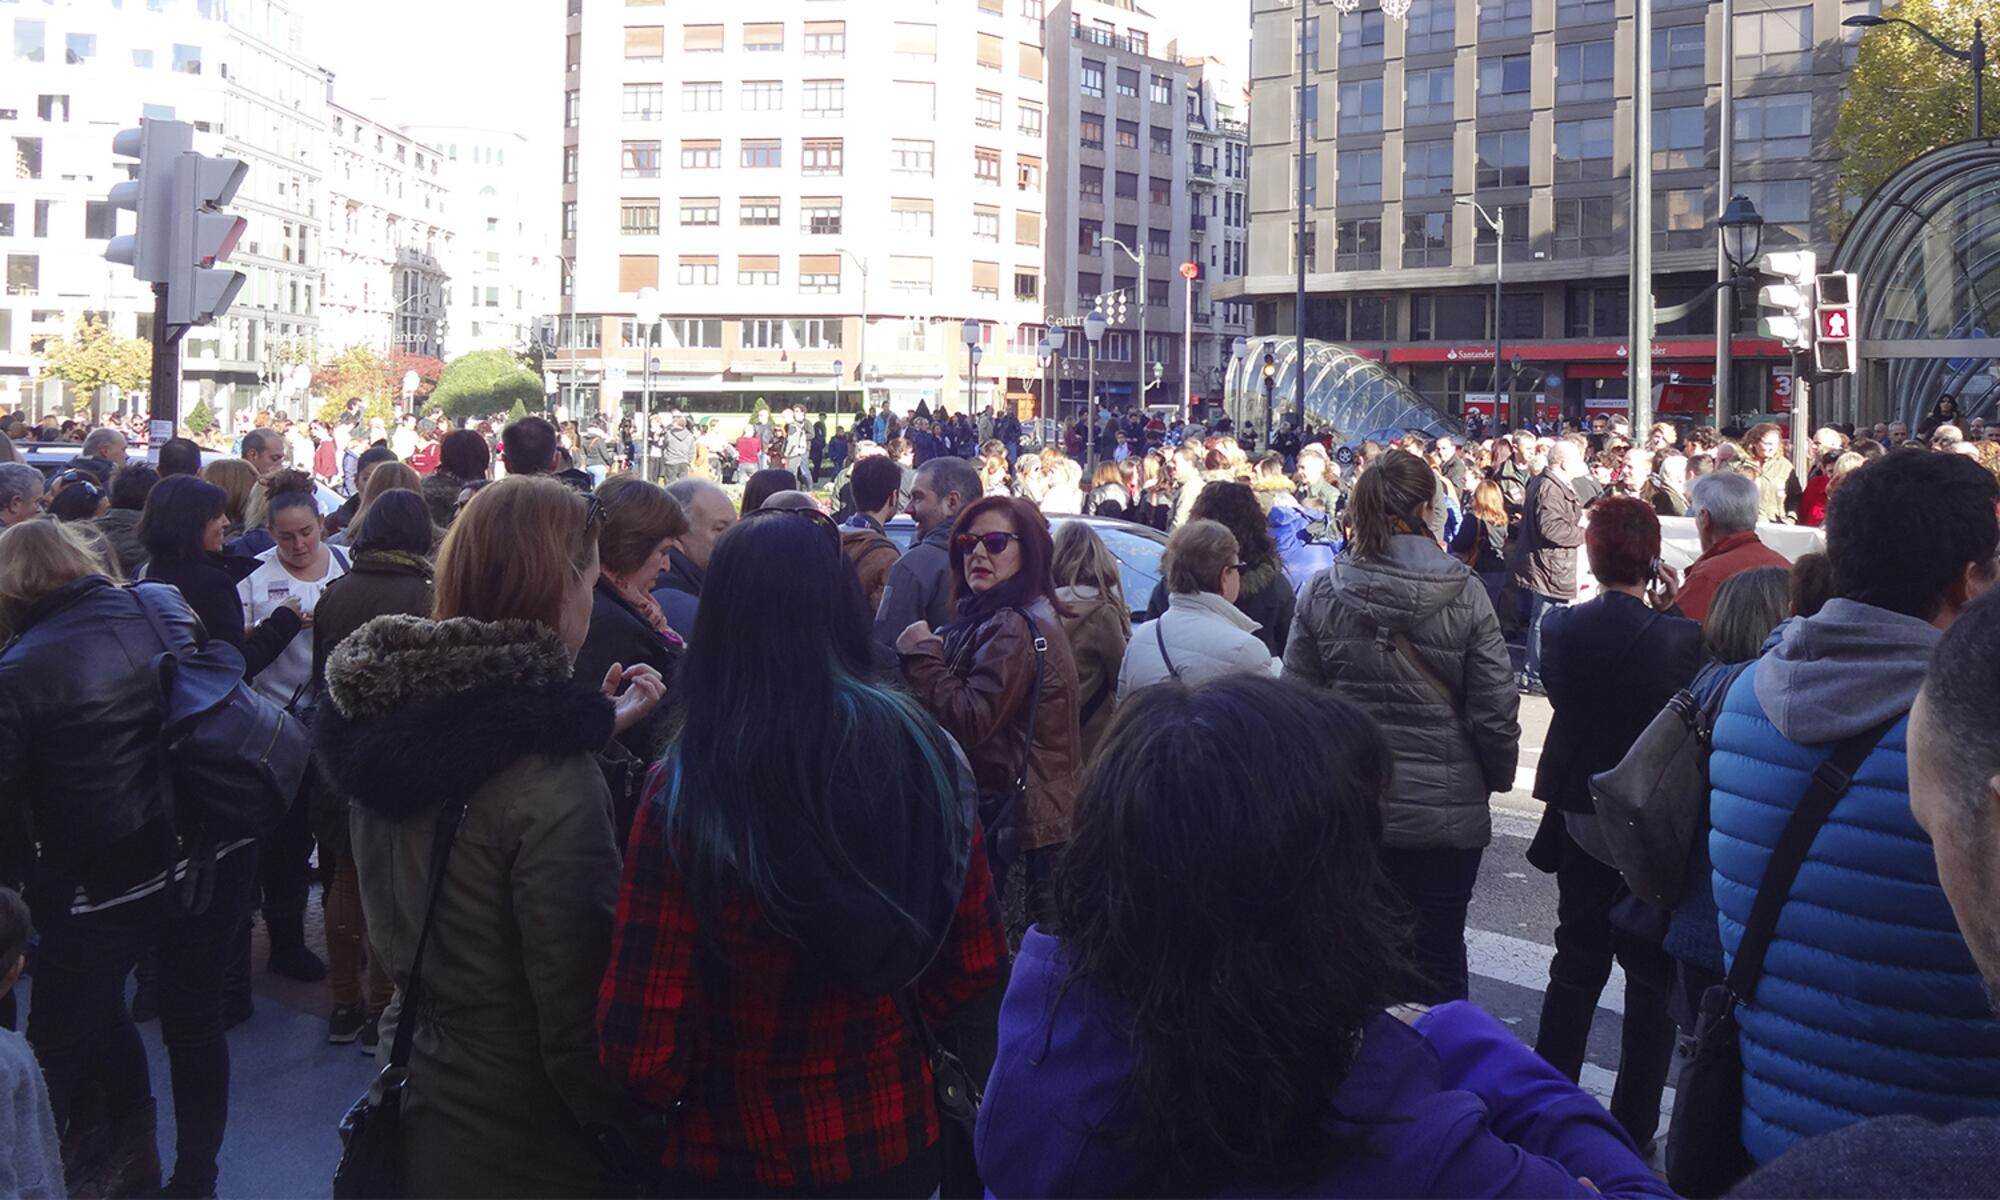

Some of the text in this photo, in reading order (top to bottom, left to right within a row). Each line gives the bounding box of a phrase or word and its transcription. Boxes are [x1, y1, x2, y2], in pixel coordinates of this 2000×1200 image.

[1045, 314, 1088, 328] Centr
[392, 333, 428, 343] entro
[1458, 349, 1496, 359] Santander
